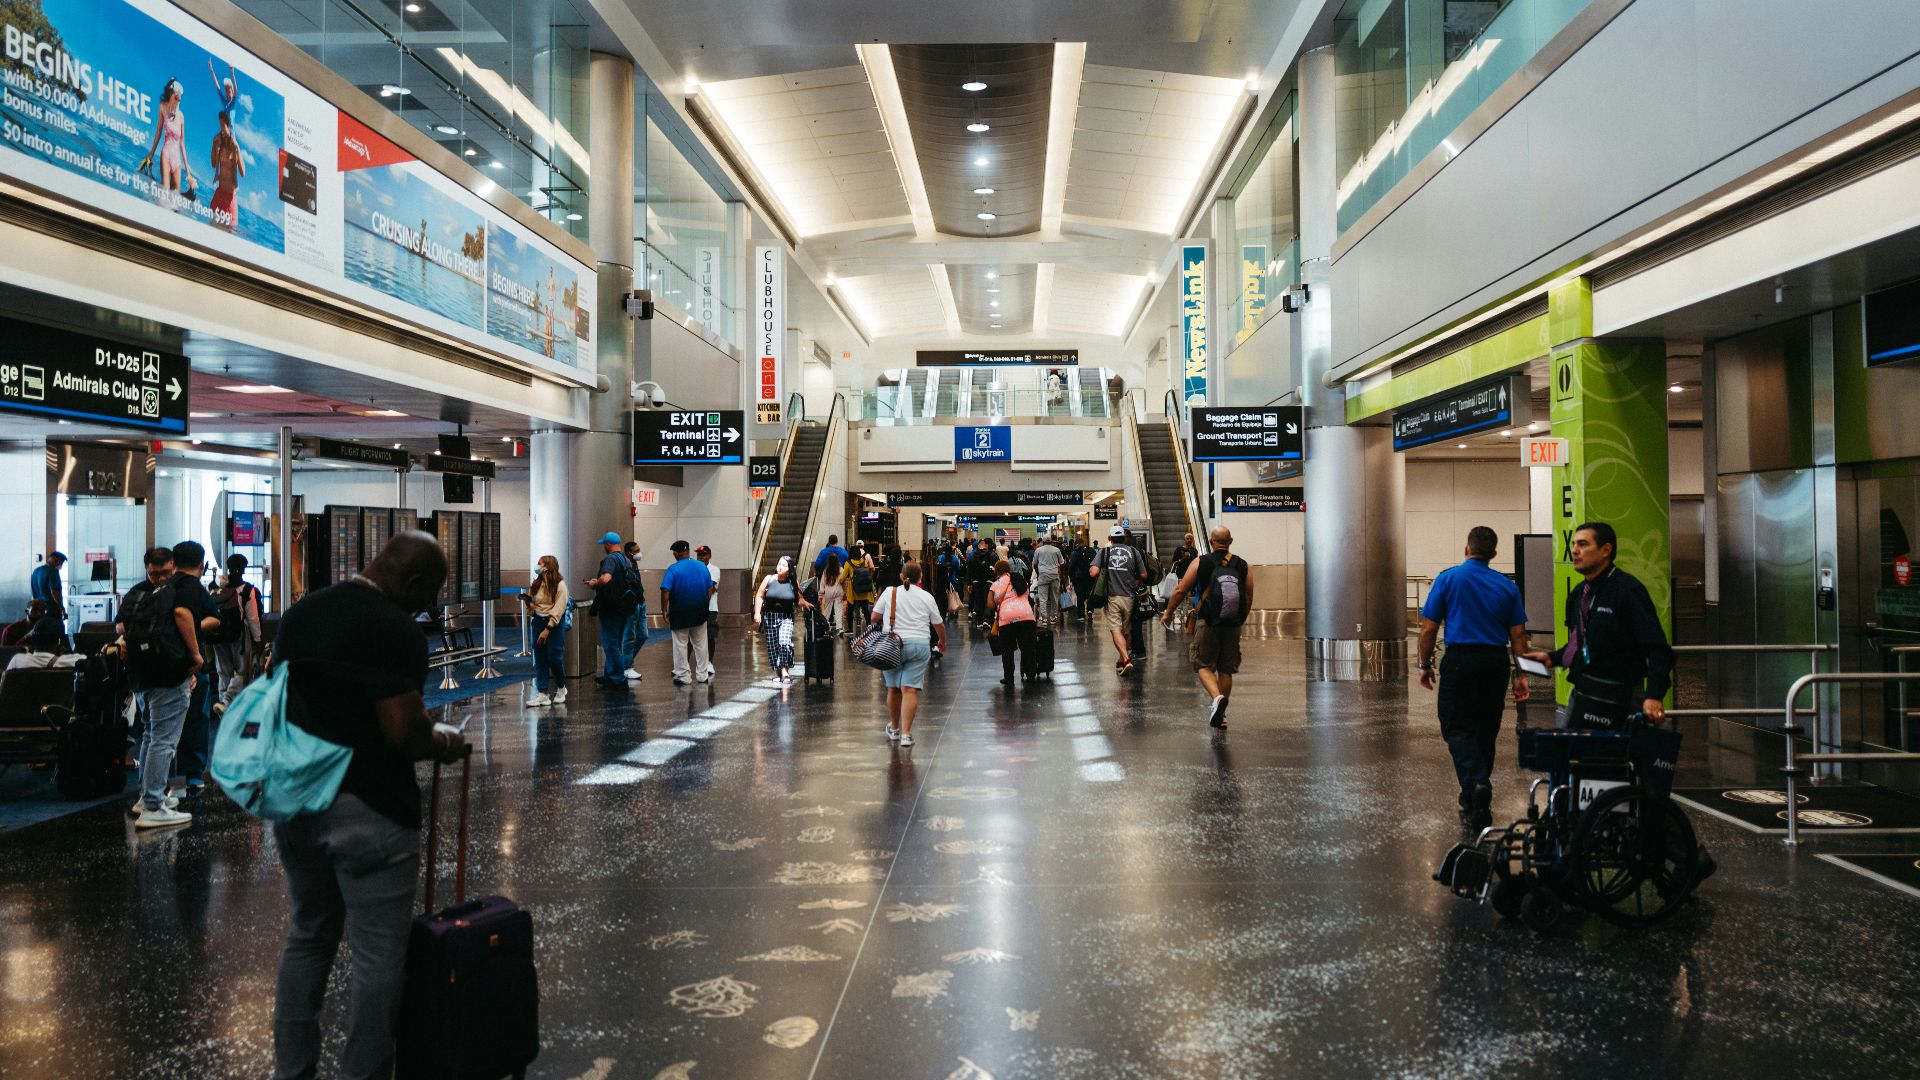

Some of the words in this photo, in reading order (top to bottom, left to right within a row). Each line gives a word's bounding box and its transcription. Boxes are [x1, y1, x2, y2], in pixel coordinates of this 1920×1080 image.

[5, 23, 93, 95] BEGINS
[97, 71, 152, 124] HERE
[4, 68, 33, 93] with
[35, 79, 78, 111] 50,000
[4, 87, 42, 120] bonus
[45, 107, 79, 136] miles.
[4, 121, 21, 142] $0
[23, 126, 53, 154] intro
[55, 142, 93, 172] annual
[95, 159, 114, 180] fee
[115, 165, 131, 186] for
[133, 174, 150, 195] the
[151, 181, 171, 202] first
[171, 191, 193, 213] year,
[194, 199, 214, 219] then
[372, 211, 420, 252] CRUISING
[421, 239, 453, 268] ALONG
[493, 272, 518, 298] BEGINS
[519, 286, 535, 307] HERE
[764, 251, 773, 356] CLUBHOUSE
[1185, 260, 1206, 379] NewsLink
[96, 348, 140, 373] D1-D25
[53, 371, 109, 396] Admirals
[113, 381, 140, 401] Club
[764, 360, 773, 397] one
[4, 385, 19, 397] D12
[128, 405, 140, 415] D15
[758, 404, 780, 412] KITCHEN
[1458, 395, 1476, 411] Terminal
[1478, 391, 1489, 404] EXIT
[671, 413, 705, 426] EXIT
[758, 414, 762, 422] &
[768, 414, 781, 423] BAR
[1206, 414, 1239, 422] Baggage
[1240, 413, 1262, 421] Claim
[660, 430, 705, 440] Terminal
[979, 435, 988, 447] 2
[1226, 433, 1262, 441] Transport
[341, 446, 359, 457] FLIGHT
[361, 449, 393, 462] INFORMATION
[661, 446, 671, 457] F,
[672, 446, 684, 457] G,
[686, 446, 697, 457] H,
[699, 446, 705, 455] J
[973, 449, 1004, 459] skytrain
[1530, 442, 1559, 464] EXIT
[753, 465, 777, 475] D25
[638, 490, 656, 503] EXIT
[1584, 712, 1613, 726] envoy
[1580, 788, 1594, 803] AA
